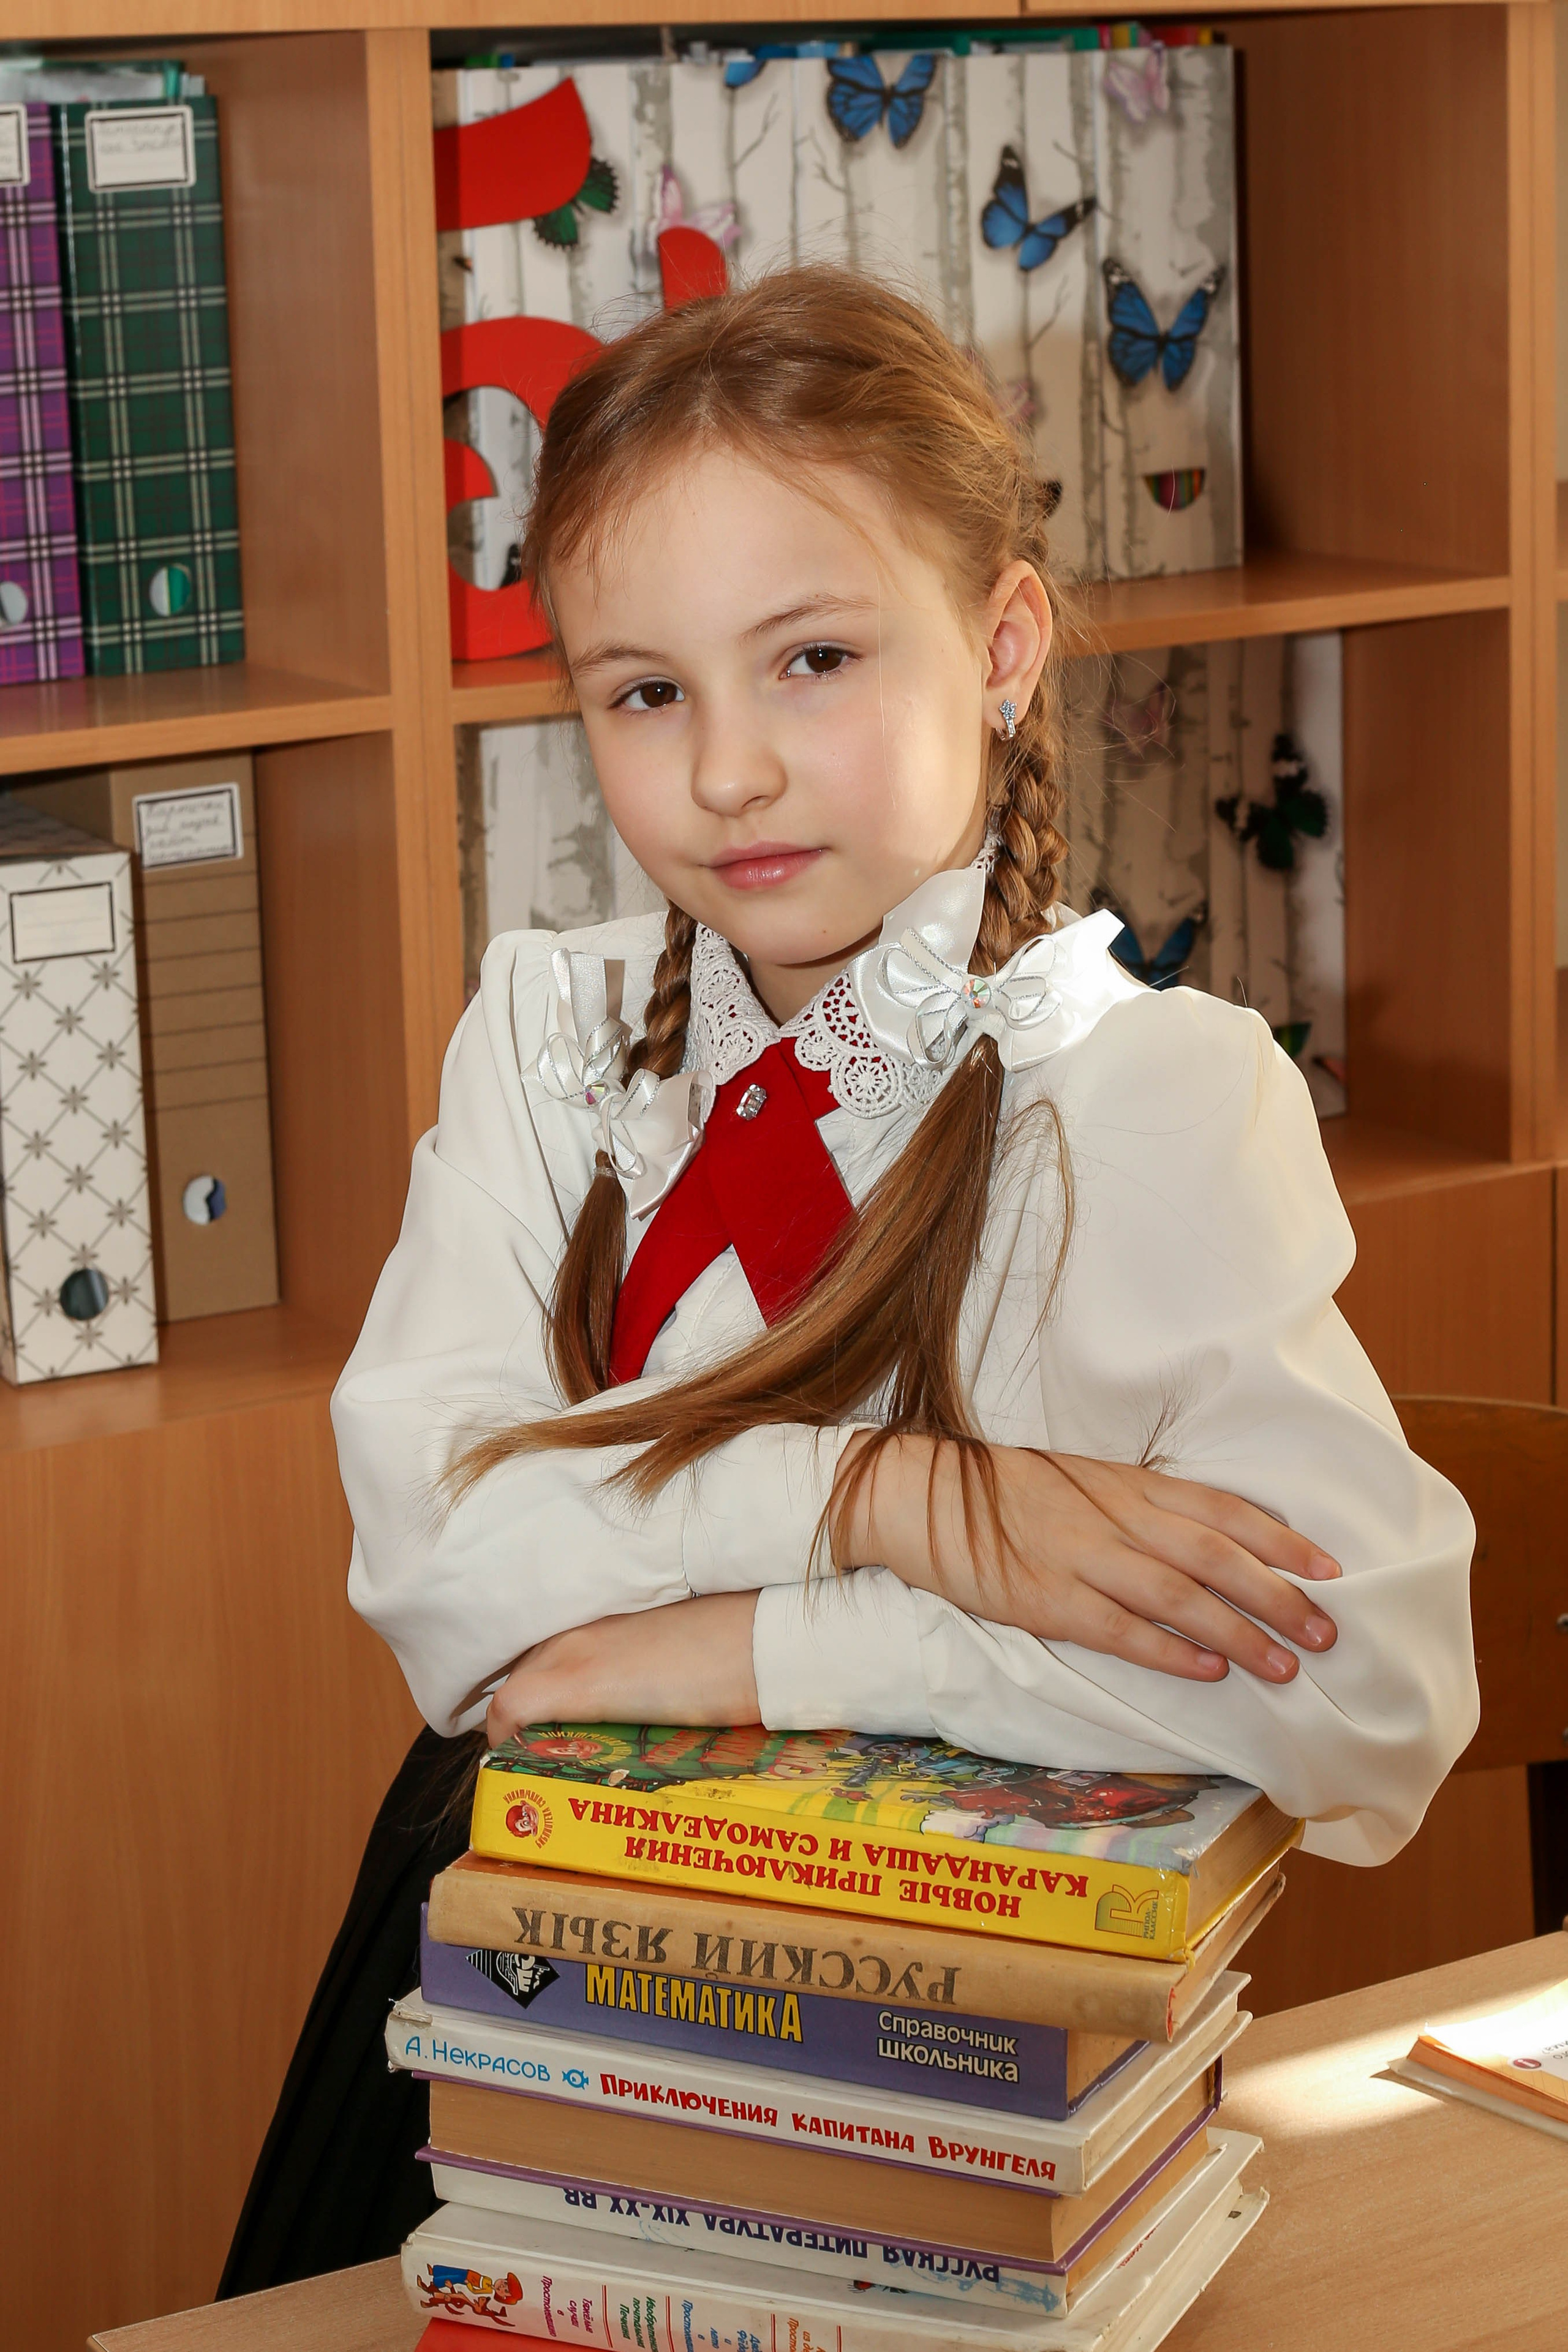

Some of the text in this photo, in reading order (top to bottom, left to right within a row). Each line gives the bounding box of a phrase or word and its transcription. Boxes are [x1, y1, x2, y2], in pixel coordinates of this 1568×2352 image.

[568, 1797, 1088, 1898] КАРАНДАША И САМОДЕЛКИНА
[624, 1836, 1022, 1918] НОВЫЕ ПРИКЛЮЧЕНИЯ
[511, 1905, 962, 2005] РУССКИЙ ЯЗЫК
[586, 1964, 803, 2043] МАТЕМАТИКА
[877, 2010, 1018, 2056] Справочник
[877, 2037, 1019, 2083] школьника
[600, 2073, 778, 2127] ПРИКЛЮЧЕНИЯ
[792, 2112, 915, 2153] КАПИТАНА
[928, 2135, 1057, 2181] ВРУНГЕЛЯ
[882, 2243, 1000, 2285] РУССКАЯ
[540, 2275, 557, 2337] Простоквашино
[567, 2300, 580, 2328] случаи
[582, 2297, 594, 2334] Тяжёлые
[619, 2303, 631, 2340] Печкина
[632, 2297, 646, 2349] почтальона
[710, 2326, 720, 2350] лето
[787, 2317, 799, 2352] Просто
